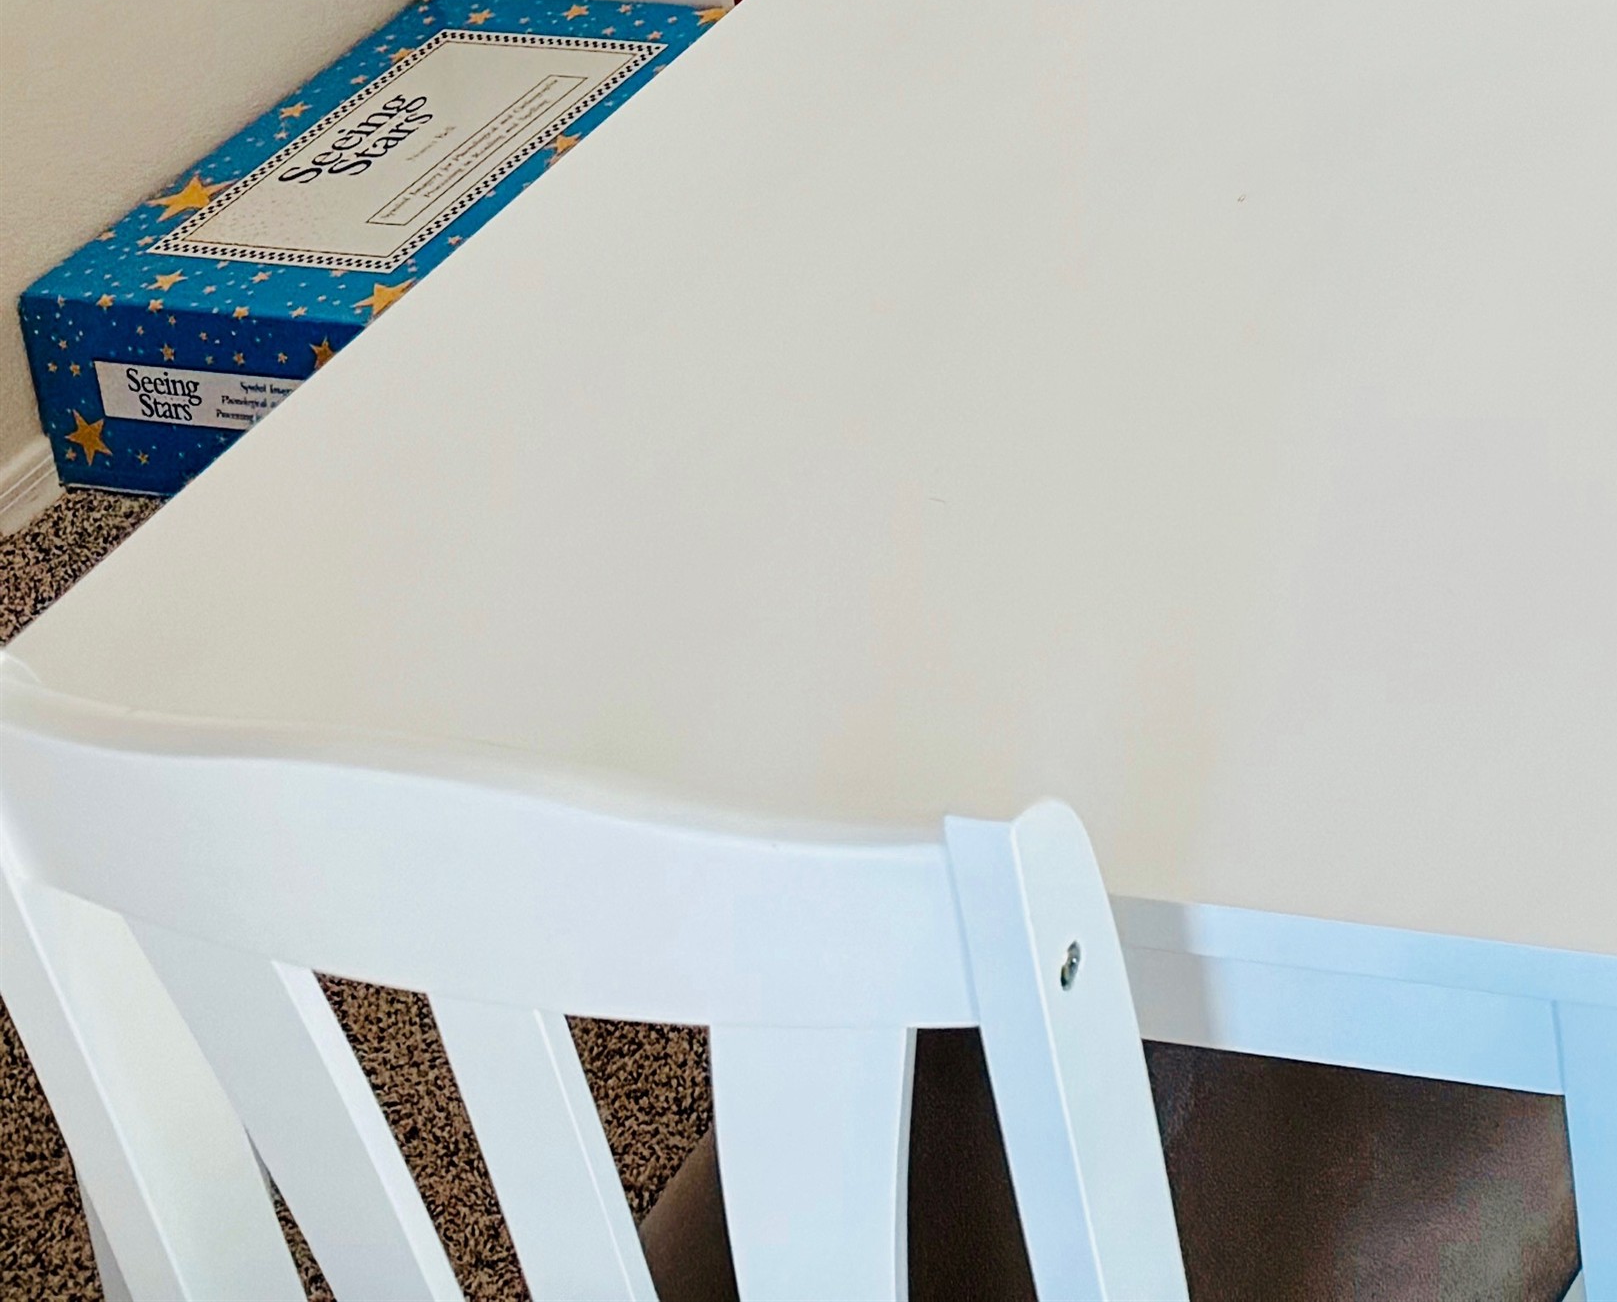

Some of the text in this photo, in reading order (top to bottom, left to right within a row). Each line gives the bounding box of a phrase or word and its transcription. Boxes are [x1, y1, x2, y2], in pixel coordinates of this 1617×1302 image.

[278, 93, 409, 185] Seeing
[327, 95, 433, 177] Stars
[126, 366, 203, 405] Seeing
[138, 393, 193, 422] Stars
